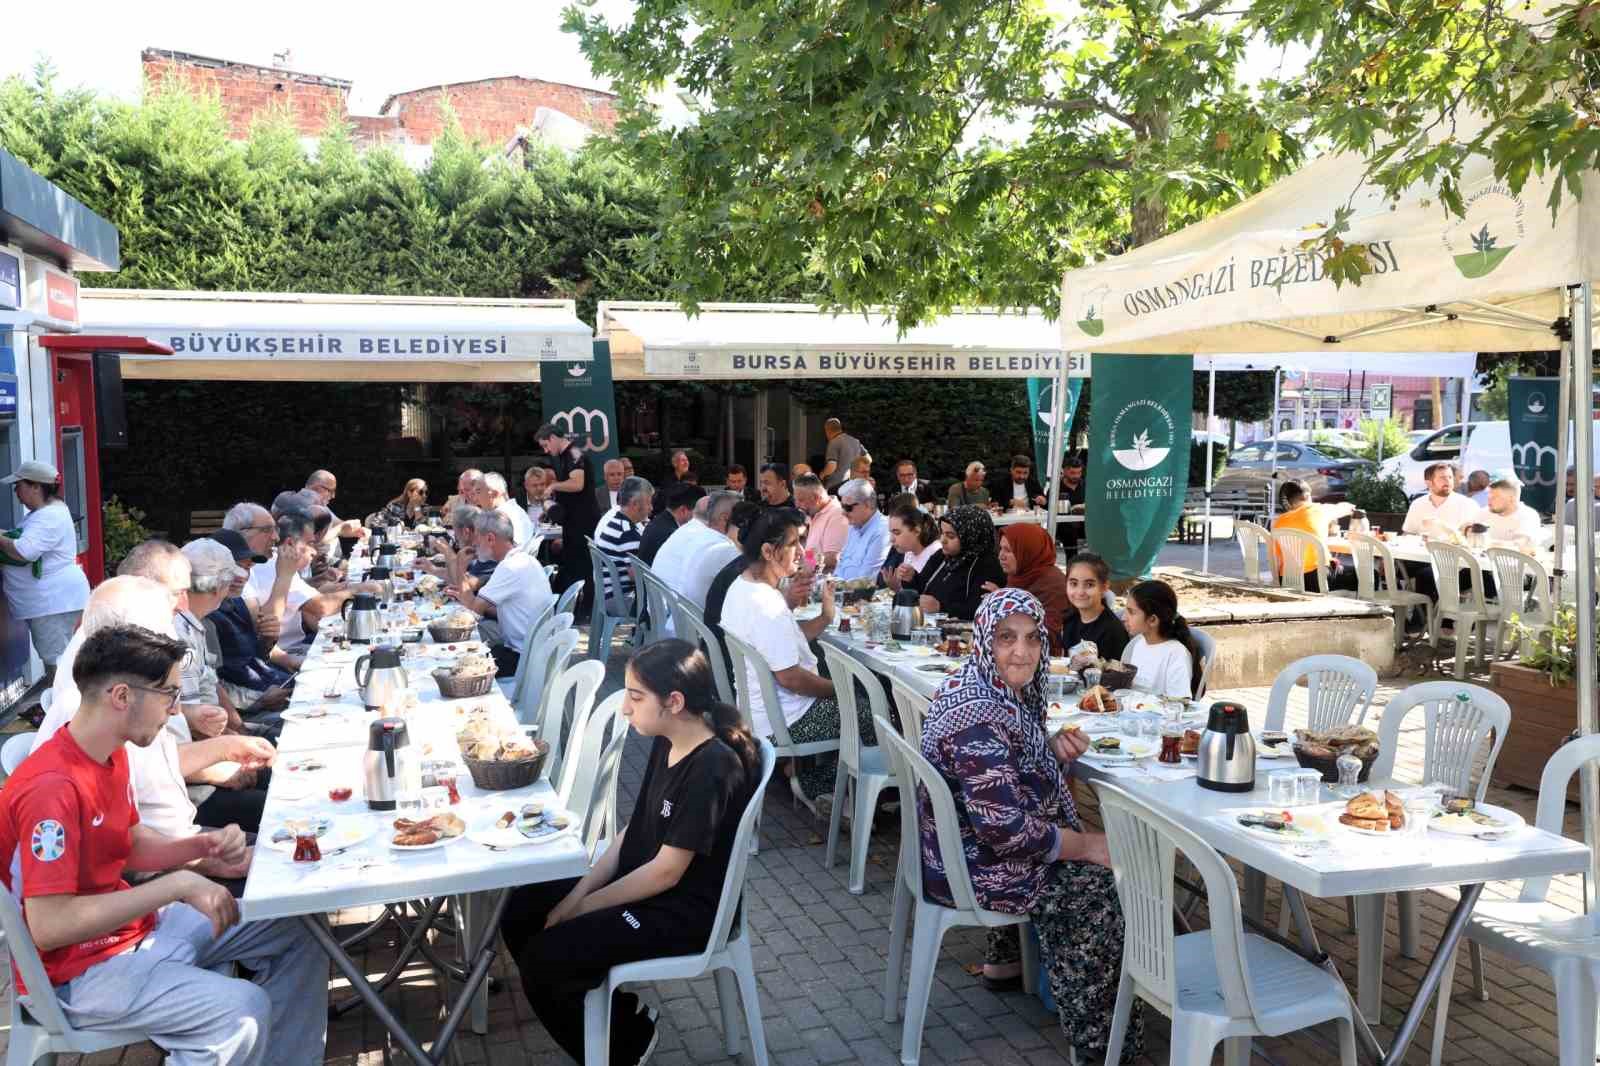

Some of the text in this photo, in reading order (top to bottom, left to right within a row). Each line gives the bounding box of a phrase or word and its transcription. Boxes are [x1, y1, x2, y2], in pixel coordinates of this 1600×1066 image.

[1124, 256, 1236, 317] OSMANGAZİ
[170, 333, 506, 357] BÜYÜKŞEHİR BELEDİYESİ
[733, 355, 807, 369] BURSA
[820, 353, 956, 373] BÜYÜKŞEHİR
[622, 910, 640, 928] VOID
